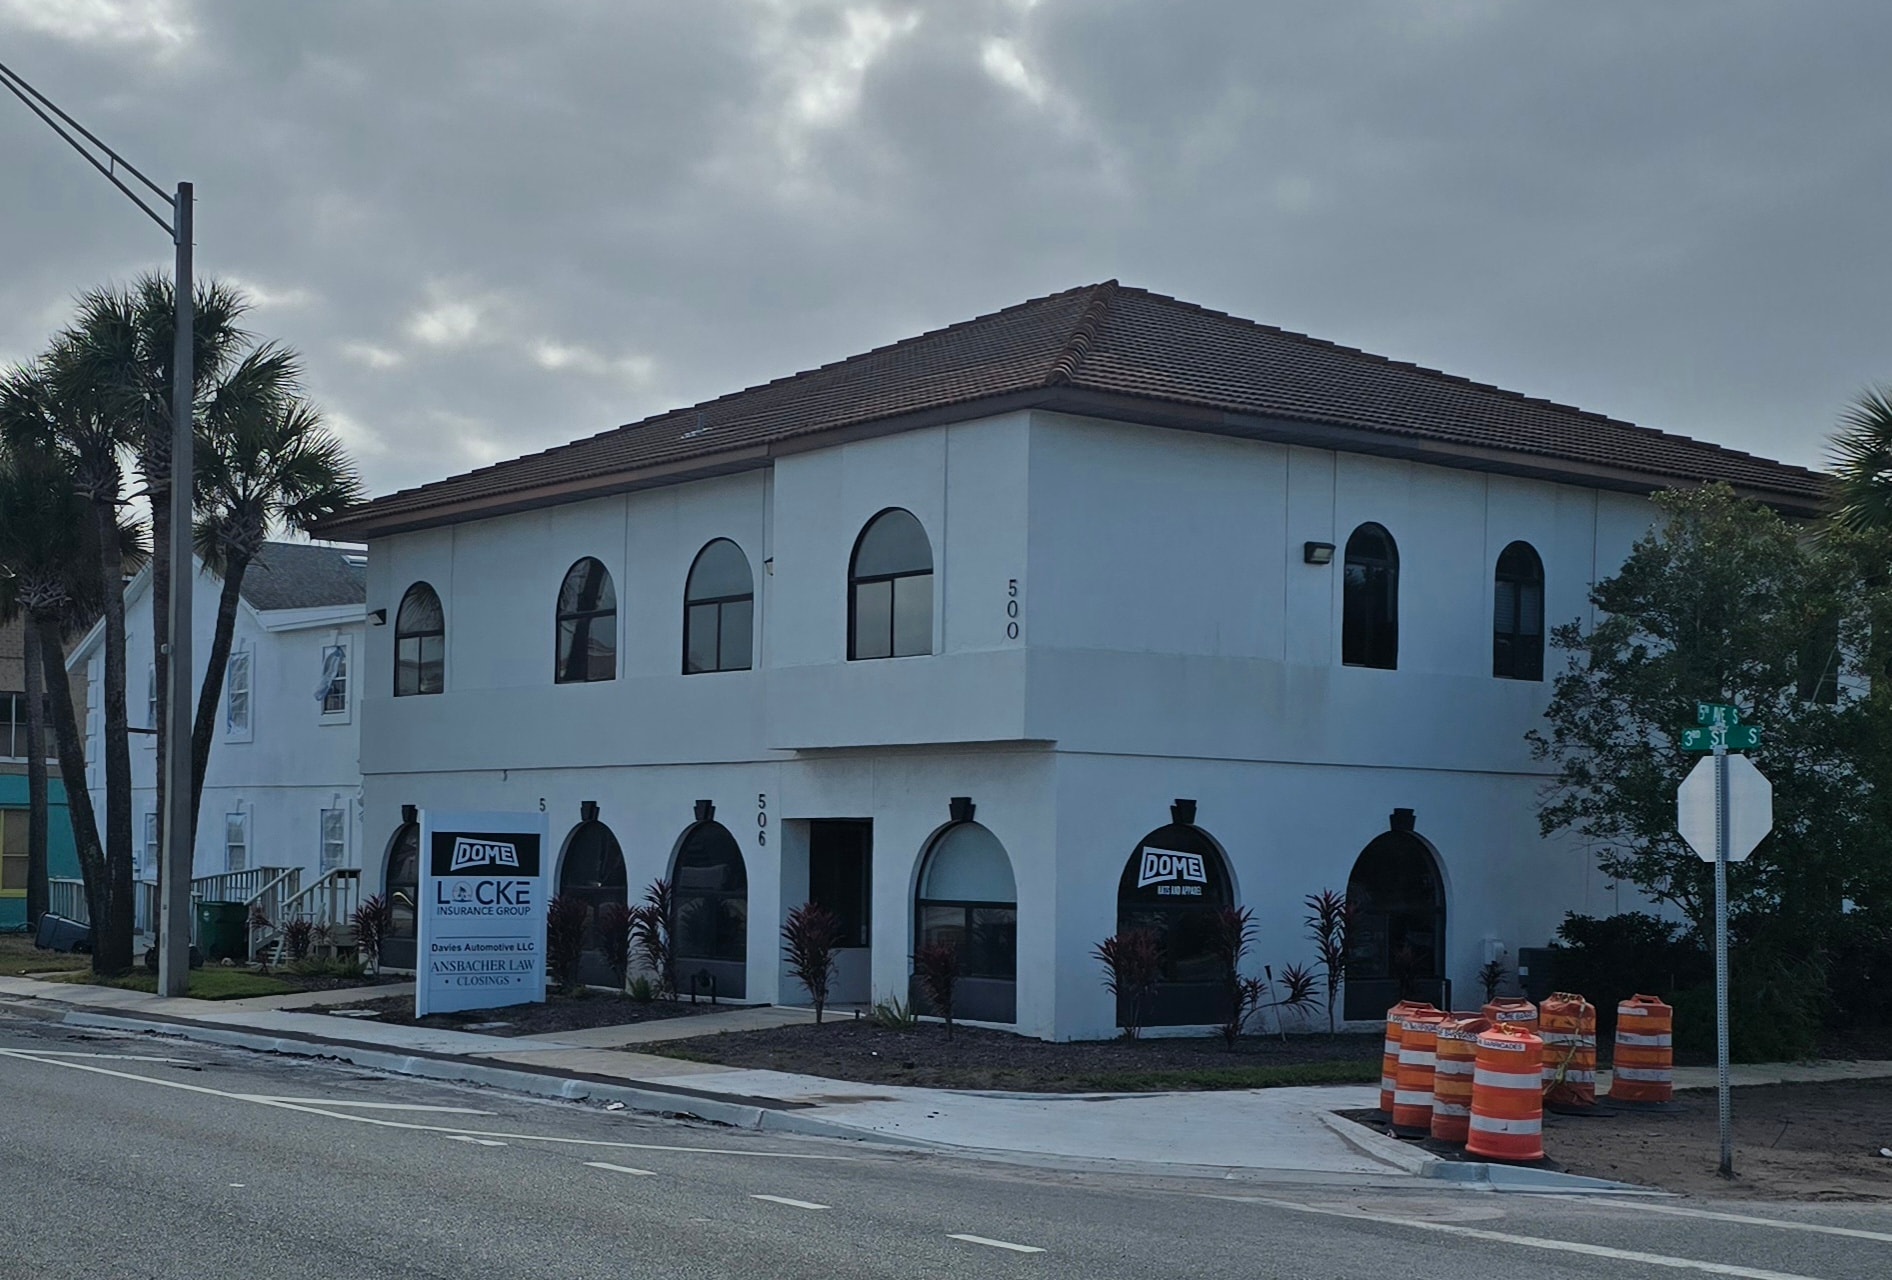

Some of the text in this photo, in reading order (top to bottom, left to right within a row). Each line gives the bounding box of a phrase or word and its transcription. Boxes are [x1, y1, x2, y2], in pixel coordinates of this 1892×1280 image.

[1007, 579, 1019, 640] 500
[1732, 708, 1739, 725] S
[1748, 727, 1758, 745] S
[757, 793, 767, 847] 506
[455, 842, 515, 865] DOME
[1143, 852, 1203, 880] DOME
[437, 880, 531, 905] LOCKE
[436, 905, 531, 916] INSURANCE GROUP
[431, 942, 535, 952] Davies Automotive LLC
[430, 959, 536, 973] ANSBACHER LAW
[456, 975, 510, 986] CLOSINGS
